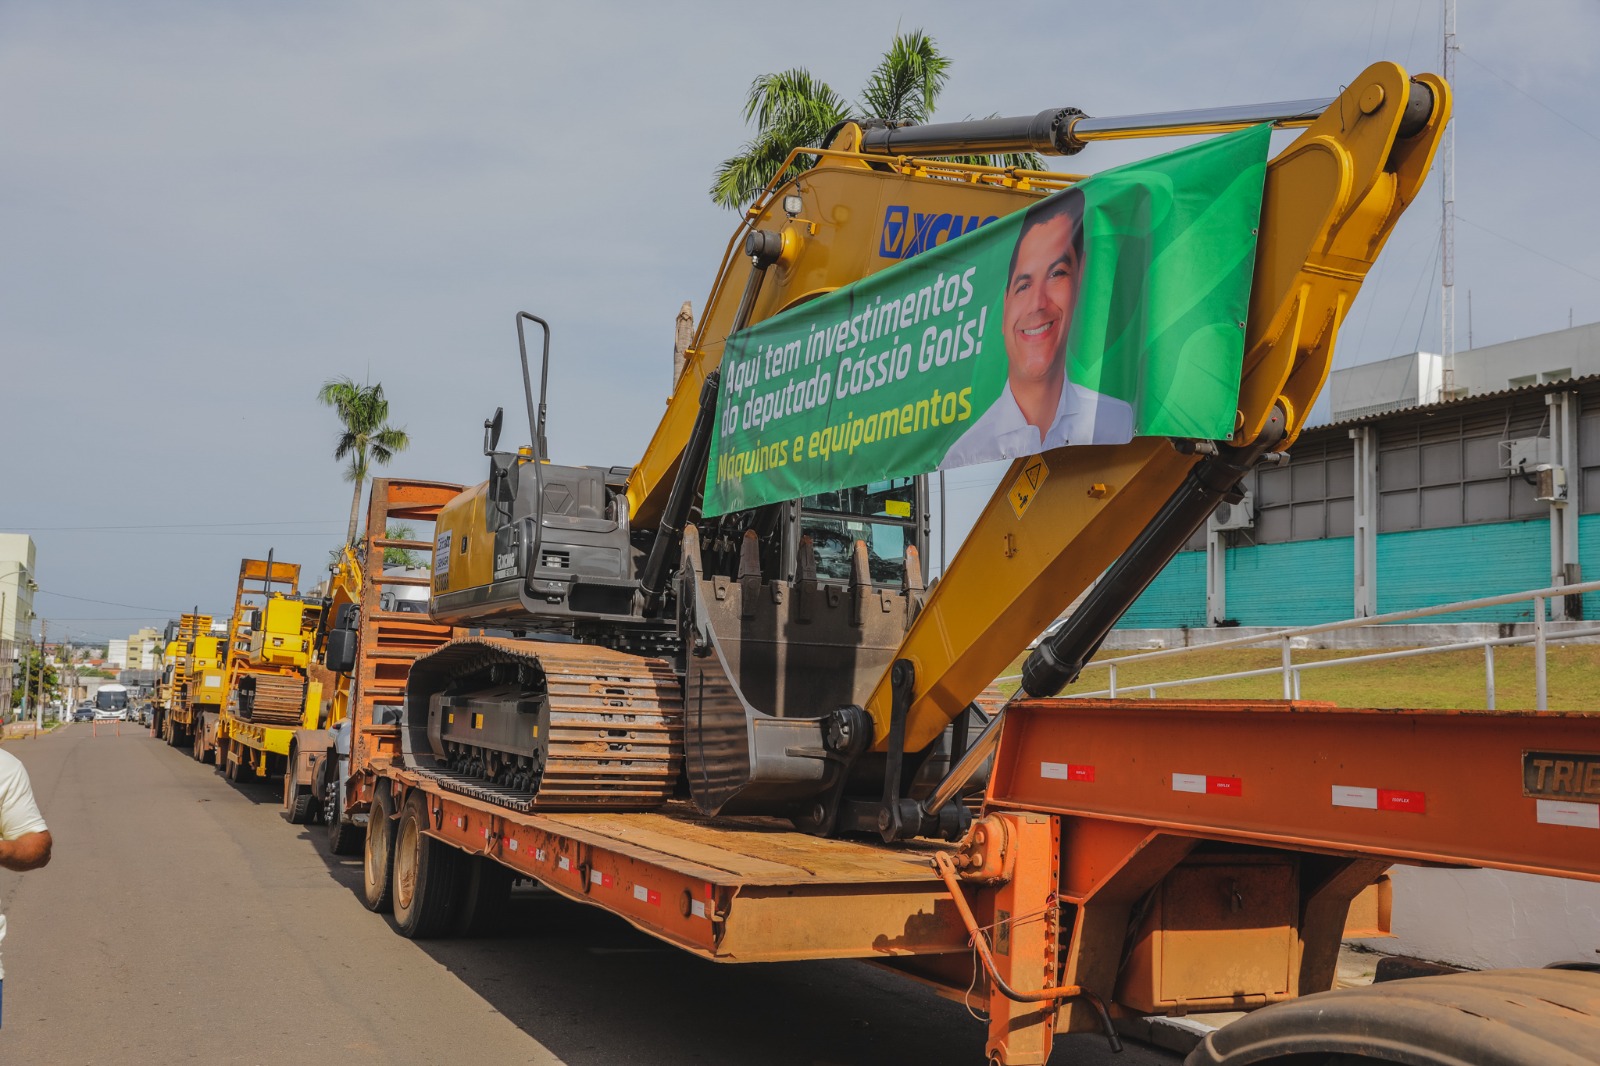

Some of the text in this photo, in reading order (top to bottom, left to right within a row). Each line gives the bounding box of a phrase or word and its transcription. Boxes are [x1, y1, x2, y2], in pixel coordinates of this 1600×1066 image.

[721, 305, 988, 438] do deputado Cássio Gois!
[725, 266, 977, 397] Aqui tem investimentos
[716, 386, 973, 490] Máquinas e equipamentos
